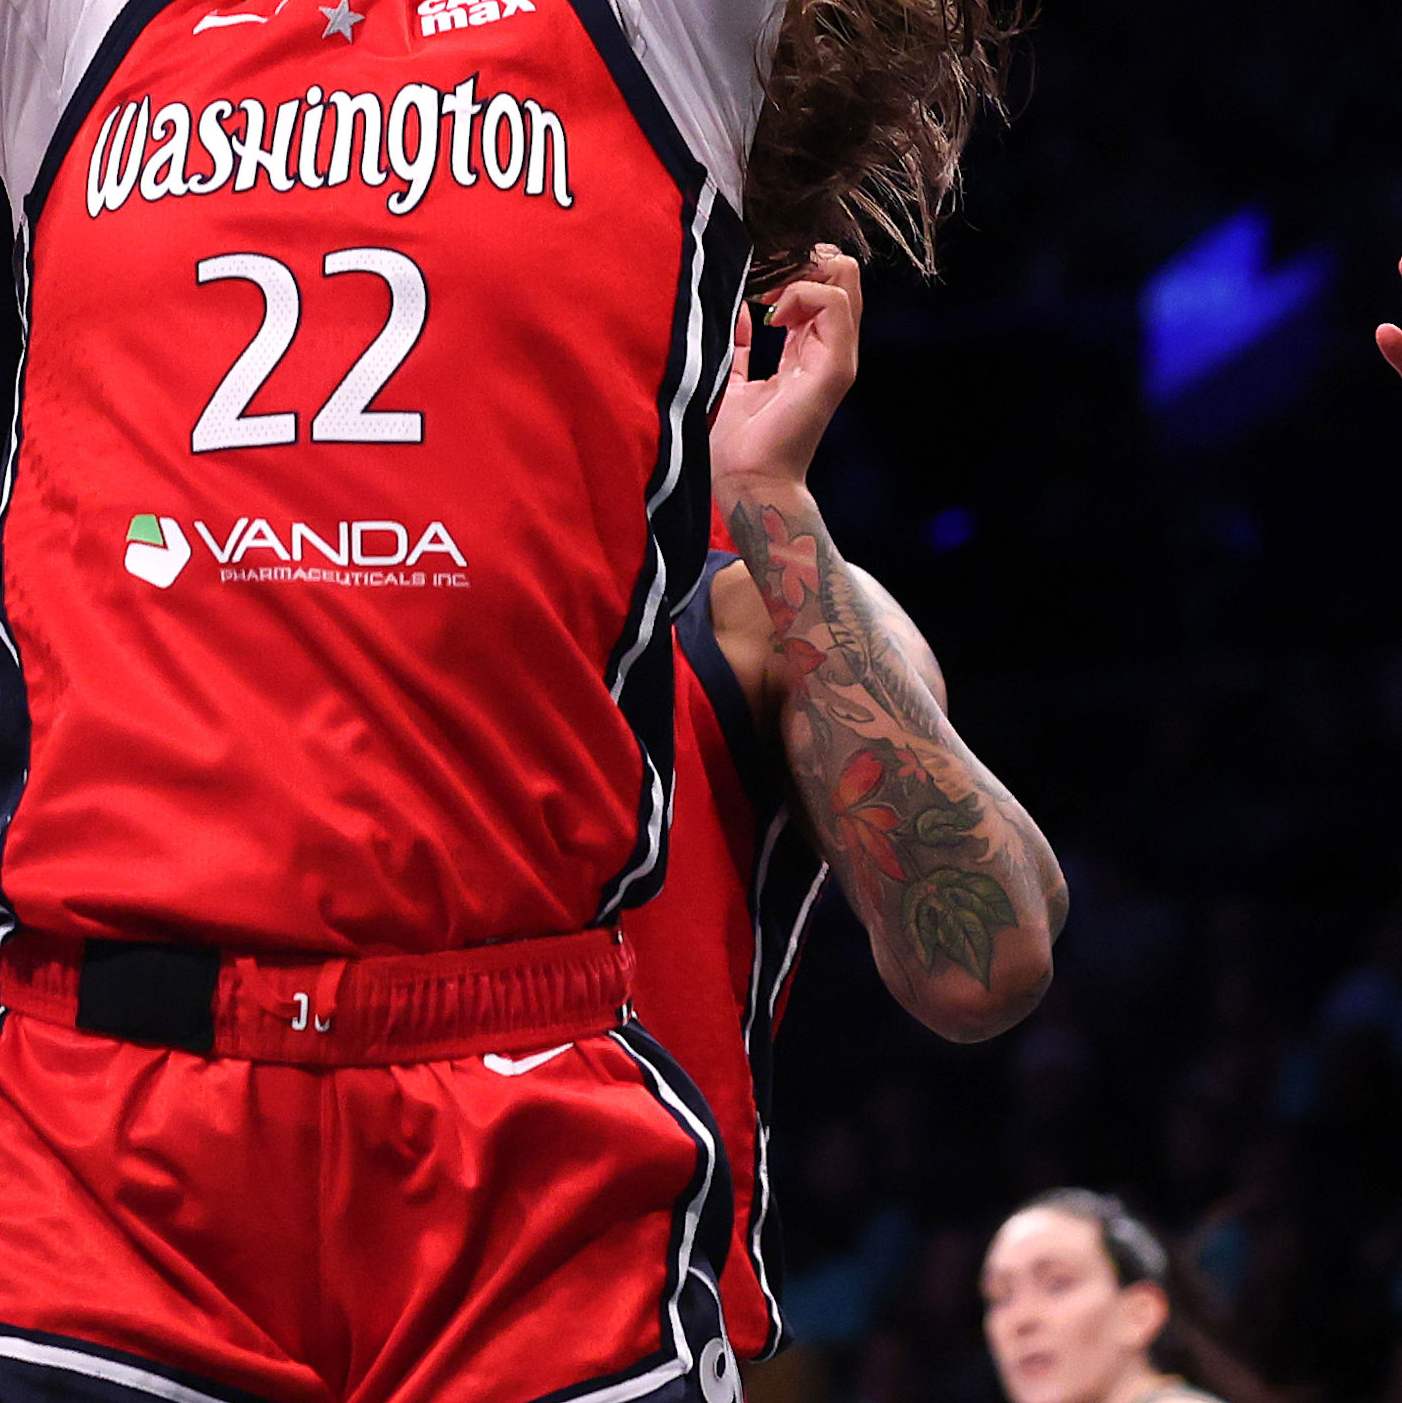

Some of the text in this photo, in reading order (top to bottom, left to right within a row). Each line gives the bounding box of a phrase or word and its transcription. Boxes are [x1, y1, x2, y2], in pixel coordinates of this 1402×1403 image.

[191, 246, 429, 454] 22
[194, 517, 468, 568] VANDA
[220, 566, 426, 587] PHARMACEUTICALS
